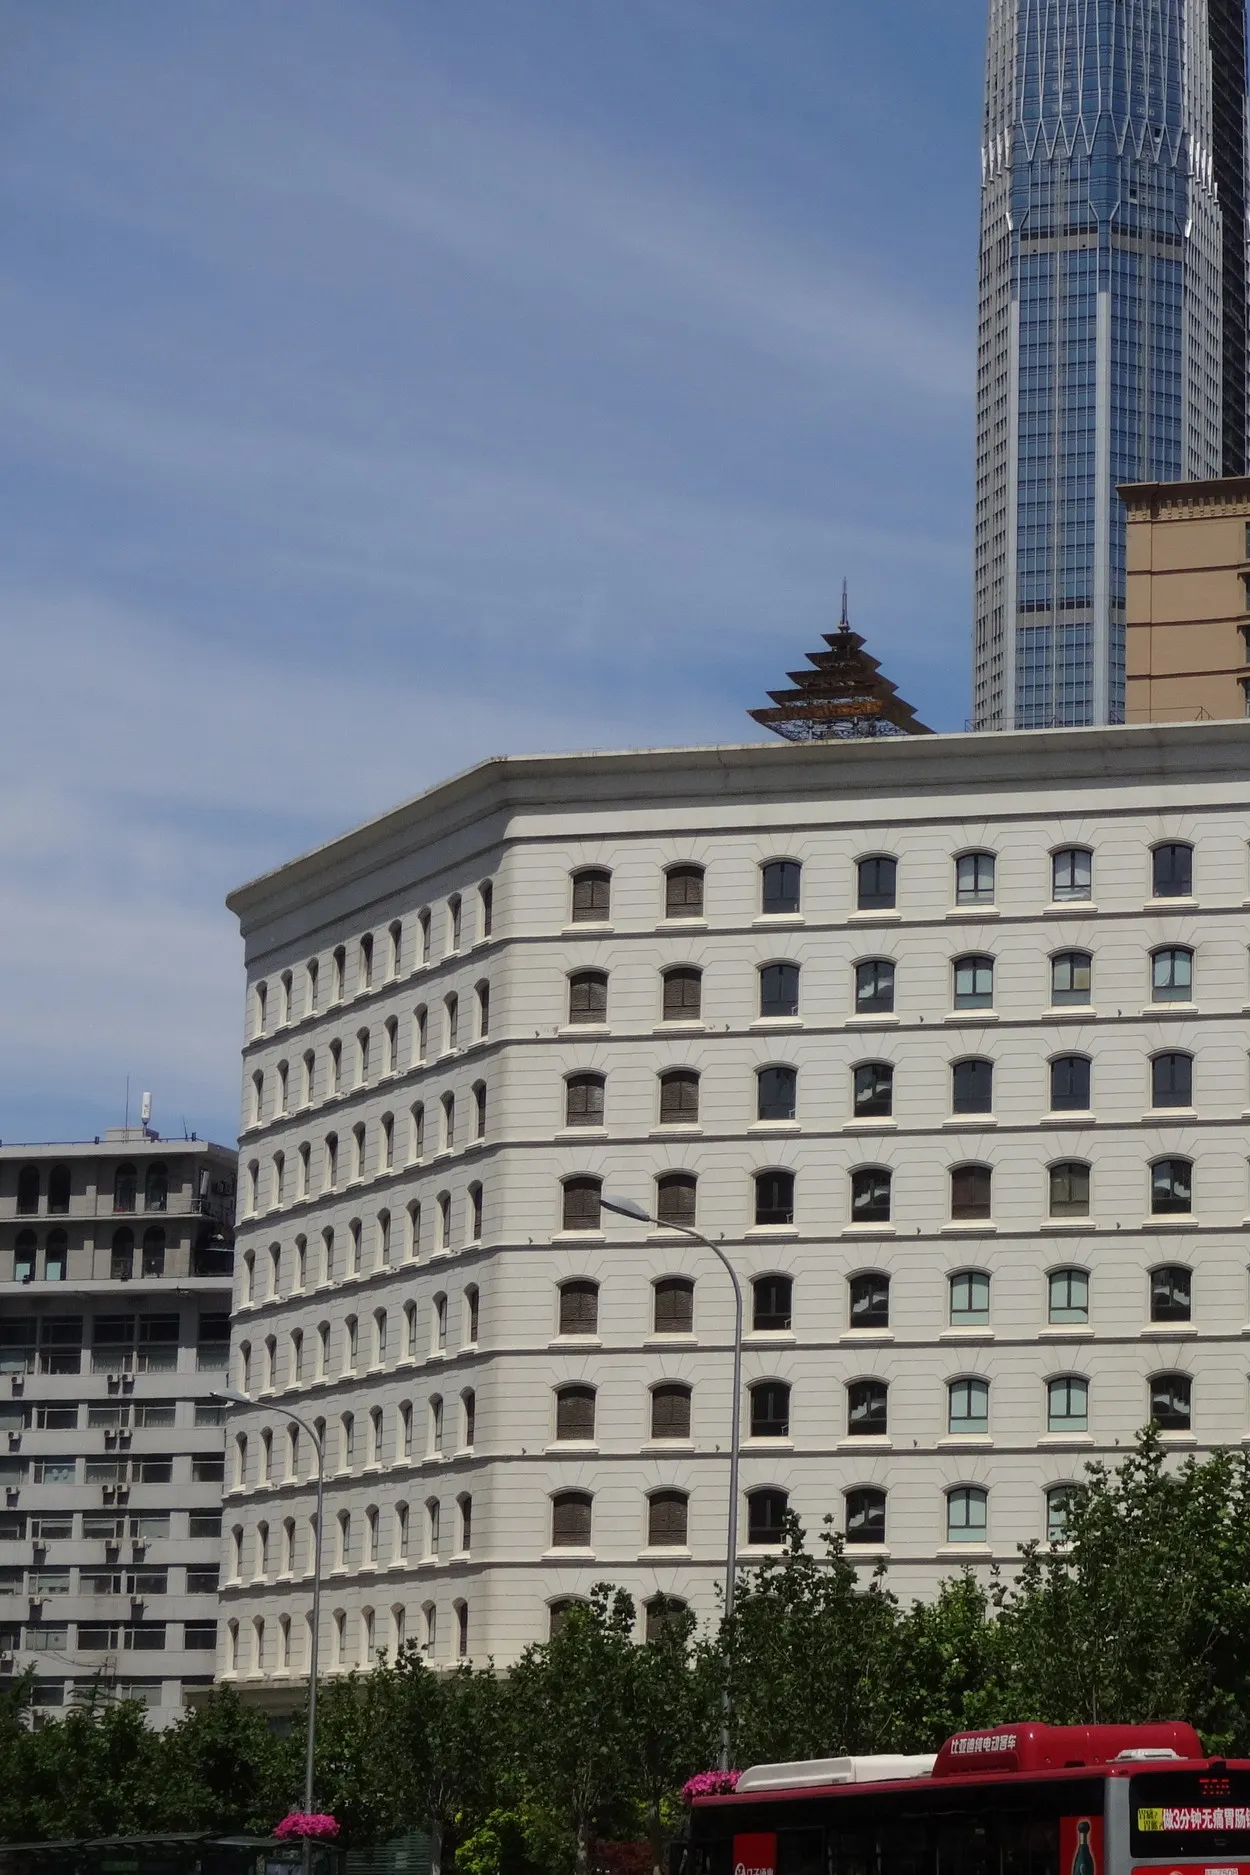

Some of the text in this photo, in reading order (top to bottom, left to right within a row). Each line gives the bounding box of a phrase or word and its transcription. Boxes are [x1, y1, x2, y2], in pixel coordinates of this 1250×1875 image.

[950, 1734, 1017, 1755] 比亚迪纯电动客车
